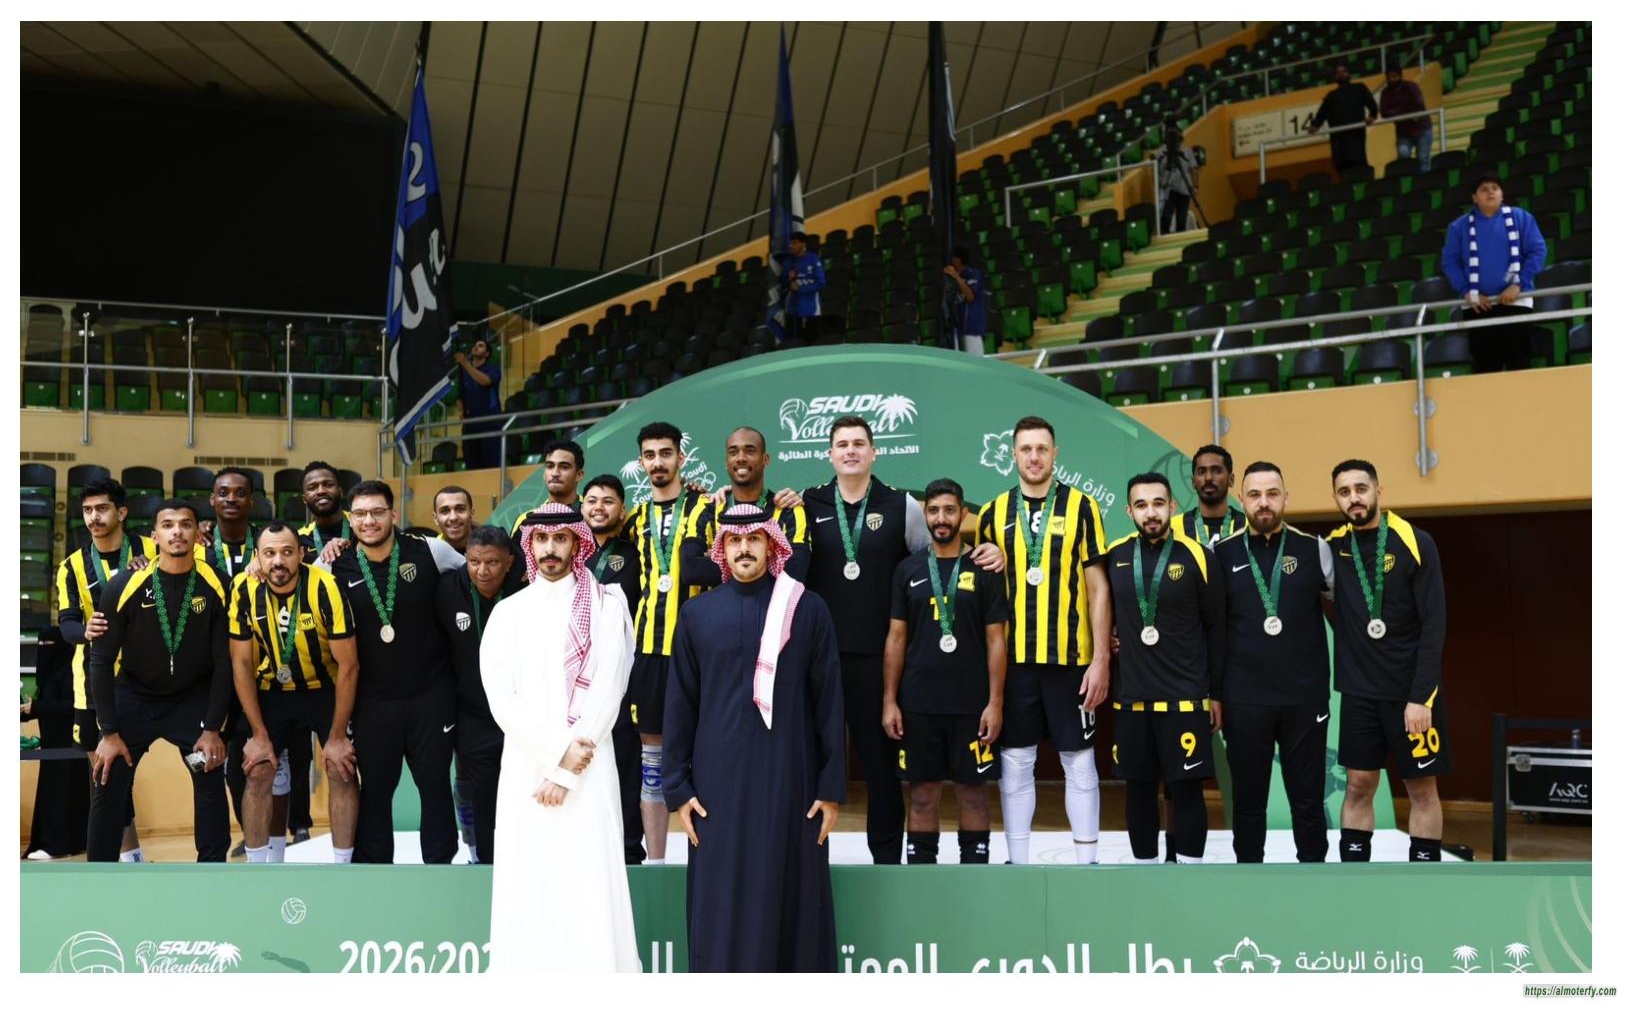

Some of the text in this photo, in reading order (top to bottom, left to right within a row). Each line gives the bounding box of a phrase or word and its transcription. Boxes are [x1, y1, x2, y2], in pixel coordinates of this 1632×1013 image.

[808, 394, 881, 415] SAUDI
[778, 450, 812, 462] الطائرة
[889, 445, 920, 455] الاتحاد
[1083, 476, 1116, 507] وزارة
[970, 740, 994, 764] 12
[1180, 732, 1197, 757] 9
[1408, 727, 1440, 757] 20
[155, 941, 218, 956] SAUDI
[1294, 951, 1424, 973] وزارة الرياضة
